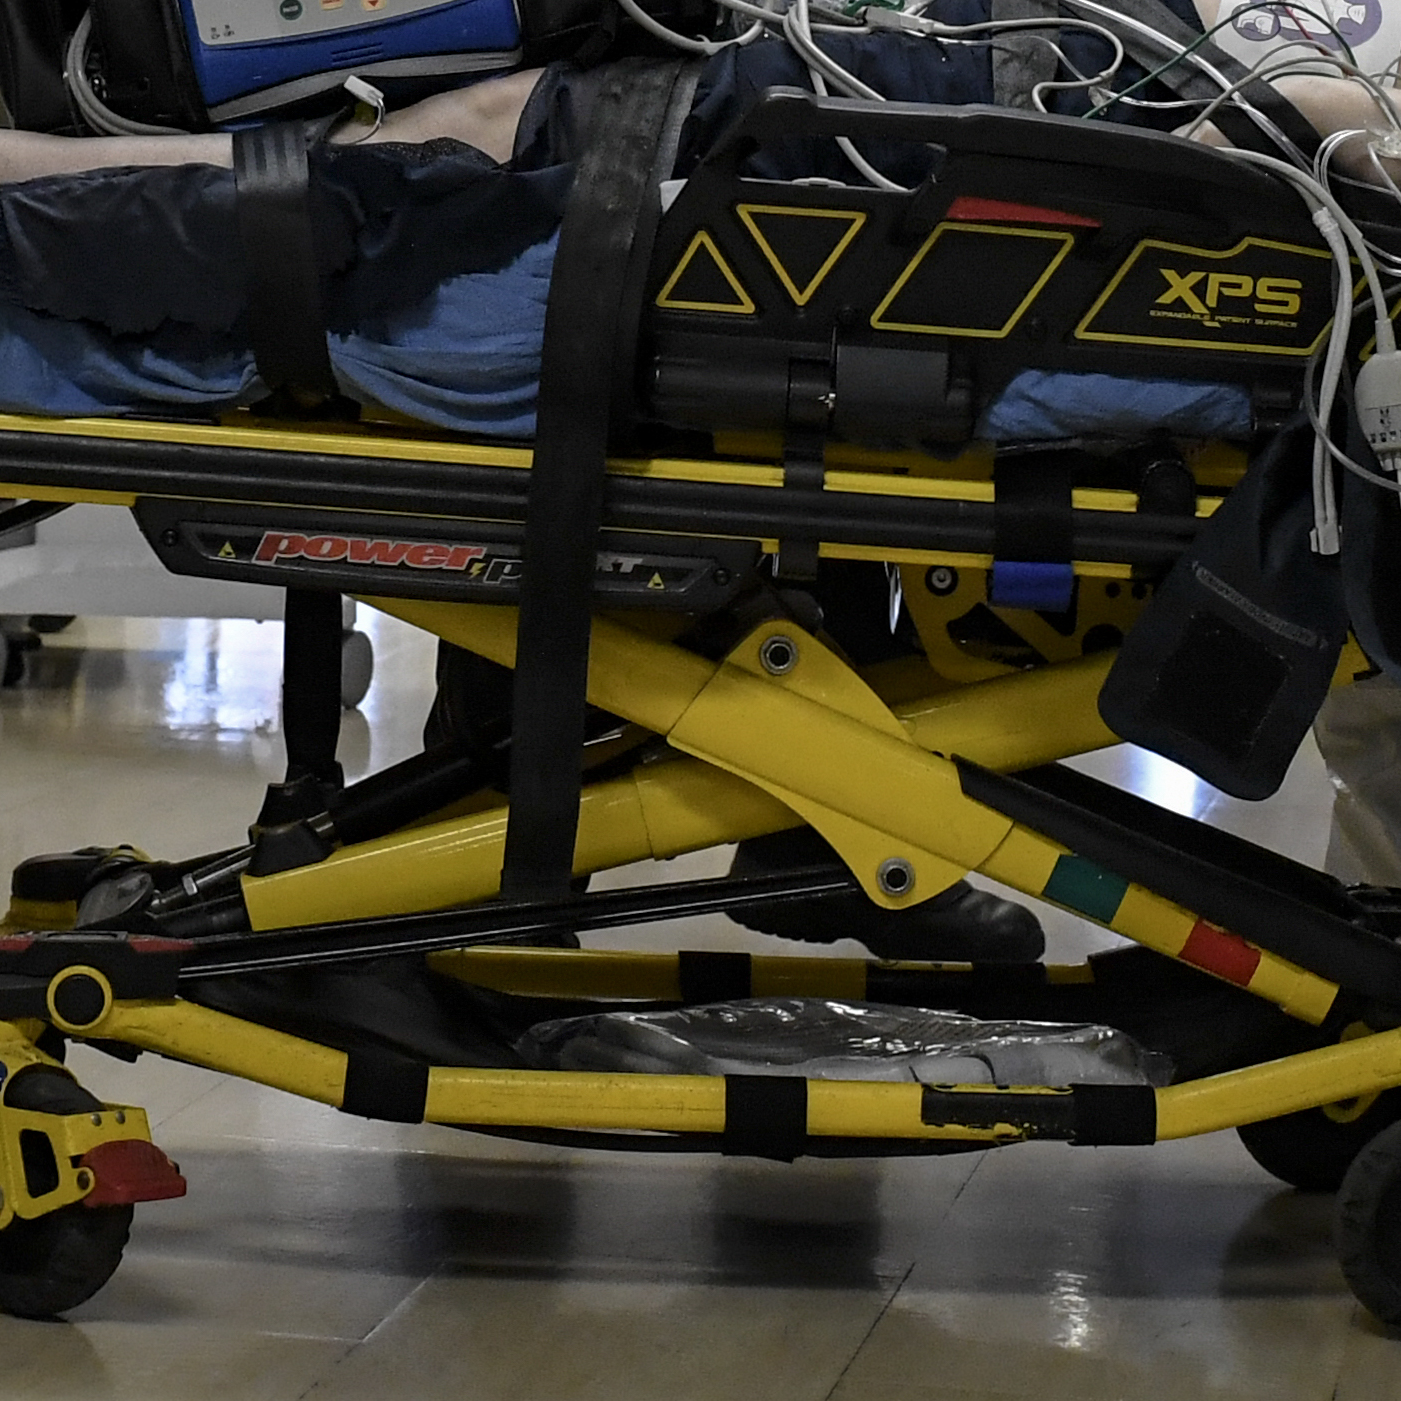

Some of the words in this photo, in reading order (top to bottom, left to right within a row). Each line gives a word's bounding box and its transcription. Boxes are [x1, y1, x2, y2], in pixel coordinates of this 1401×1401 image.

[1154, 268, 1302, 315] XPS
[1254, 318, 1298, 328] SURFACE
[251, 530, 487, 571] power
